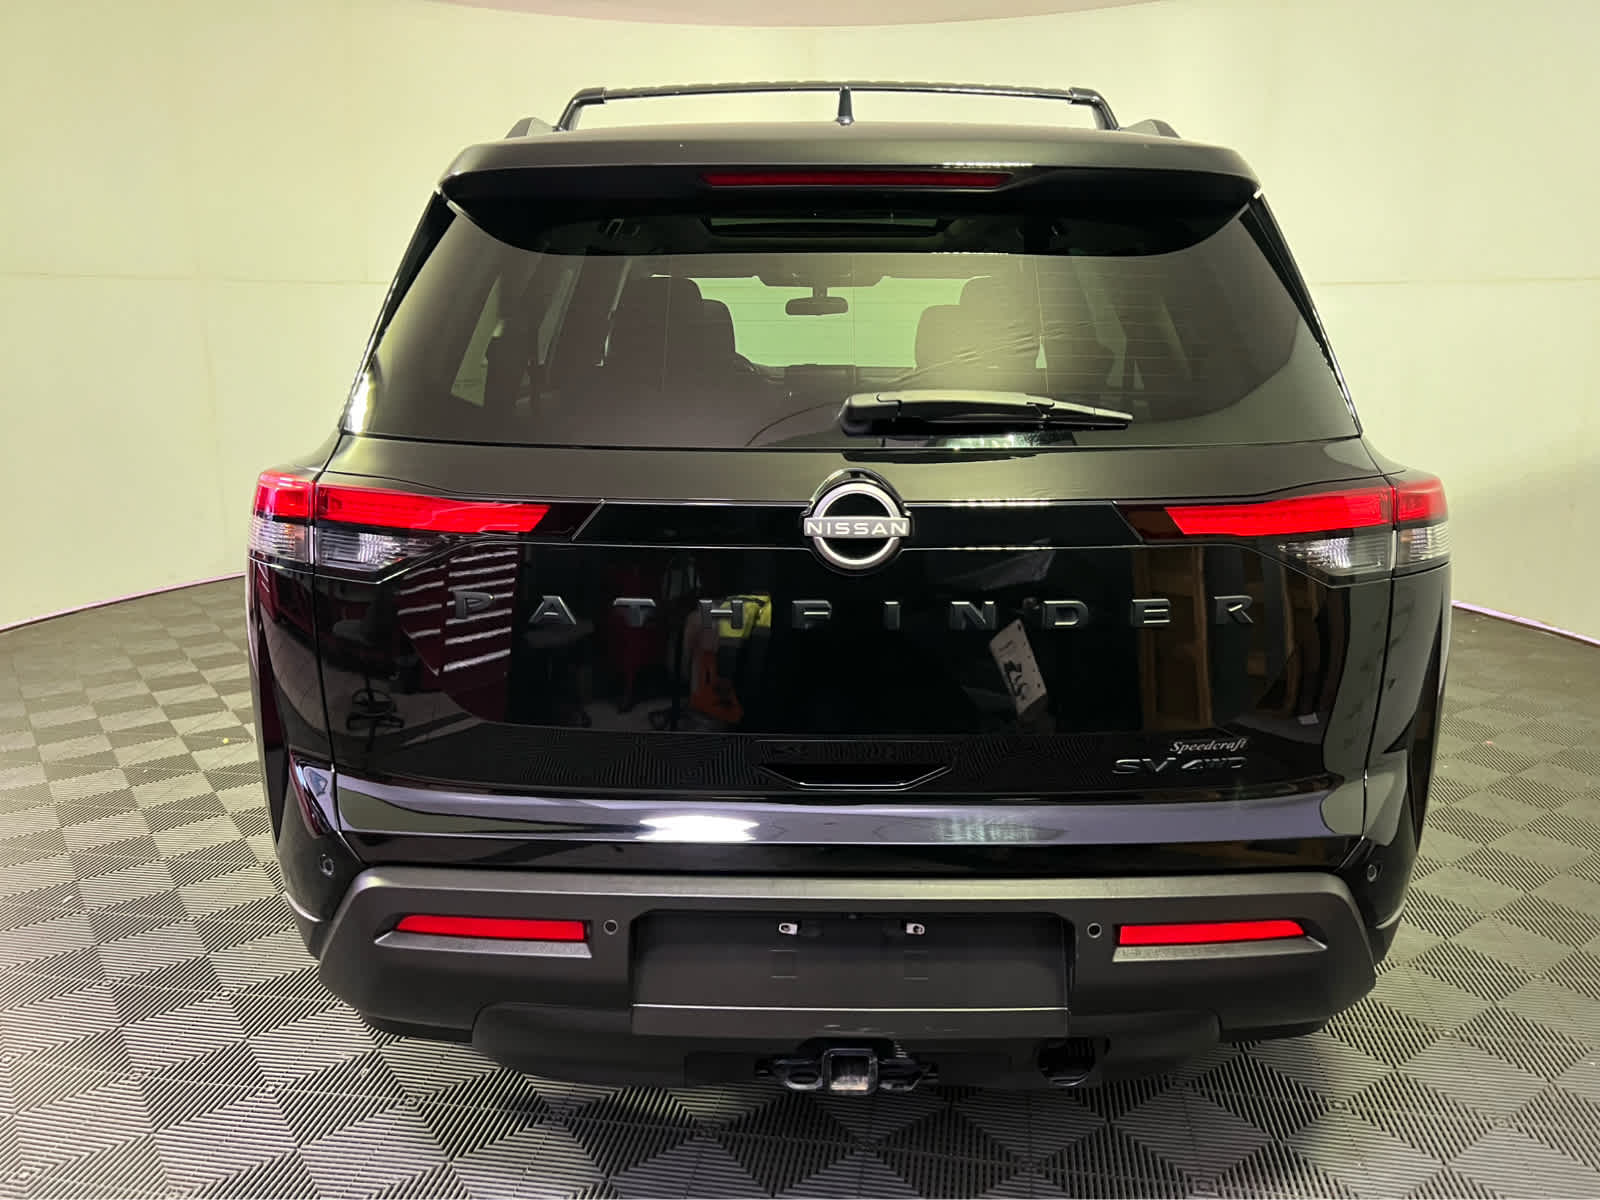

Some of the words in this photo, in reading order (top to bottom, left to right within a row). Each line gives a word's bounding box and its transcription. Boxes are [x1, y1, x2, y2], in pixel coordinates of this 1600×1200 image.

[806, 521, 907, 536] NISSAN
[453, 591, 1254, 630] PATHFINDER
[1169, 737, 1249, 755] Speedcraft
[1111, 756, 1177, 775] SV
[1180, 756, 1248, 772] 4WD
